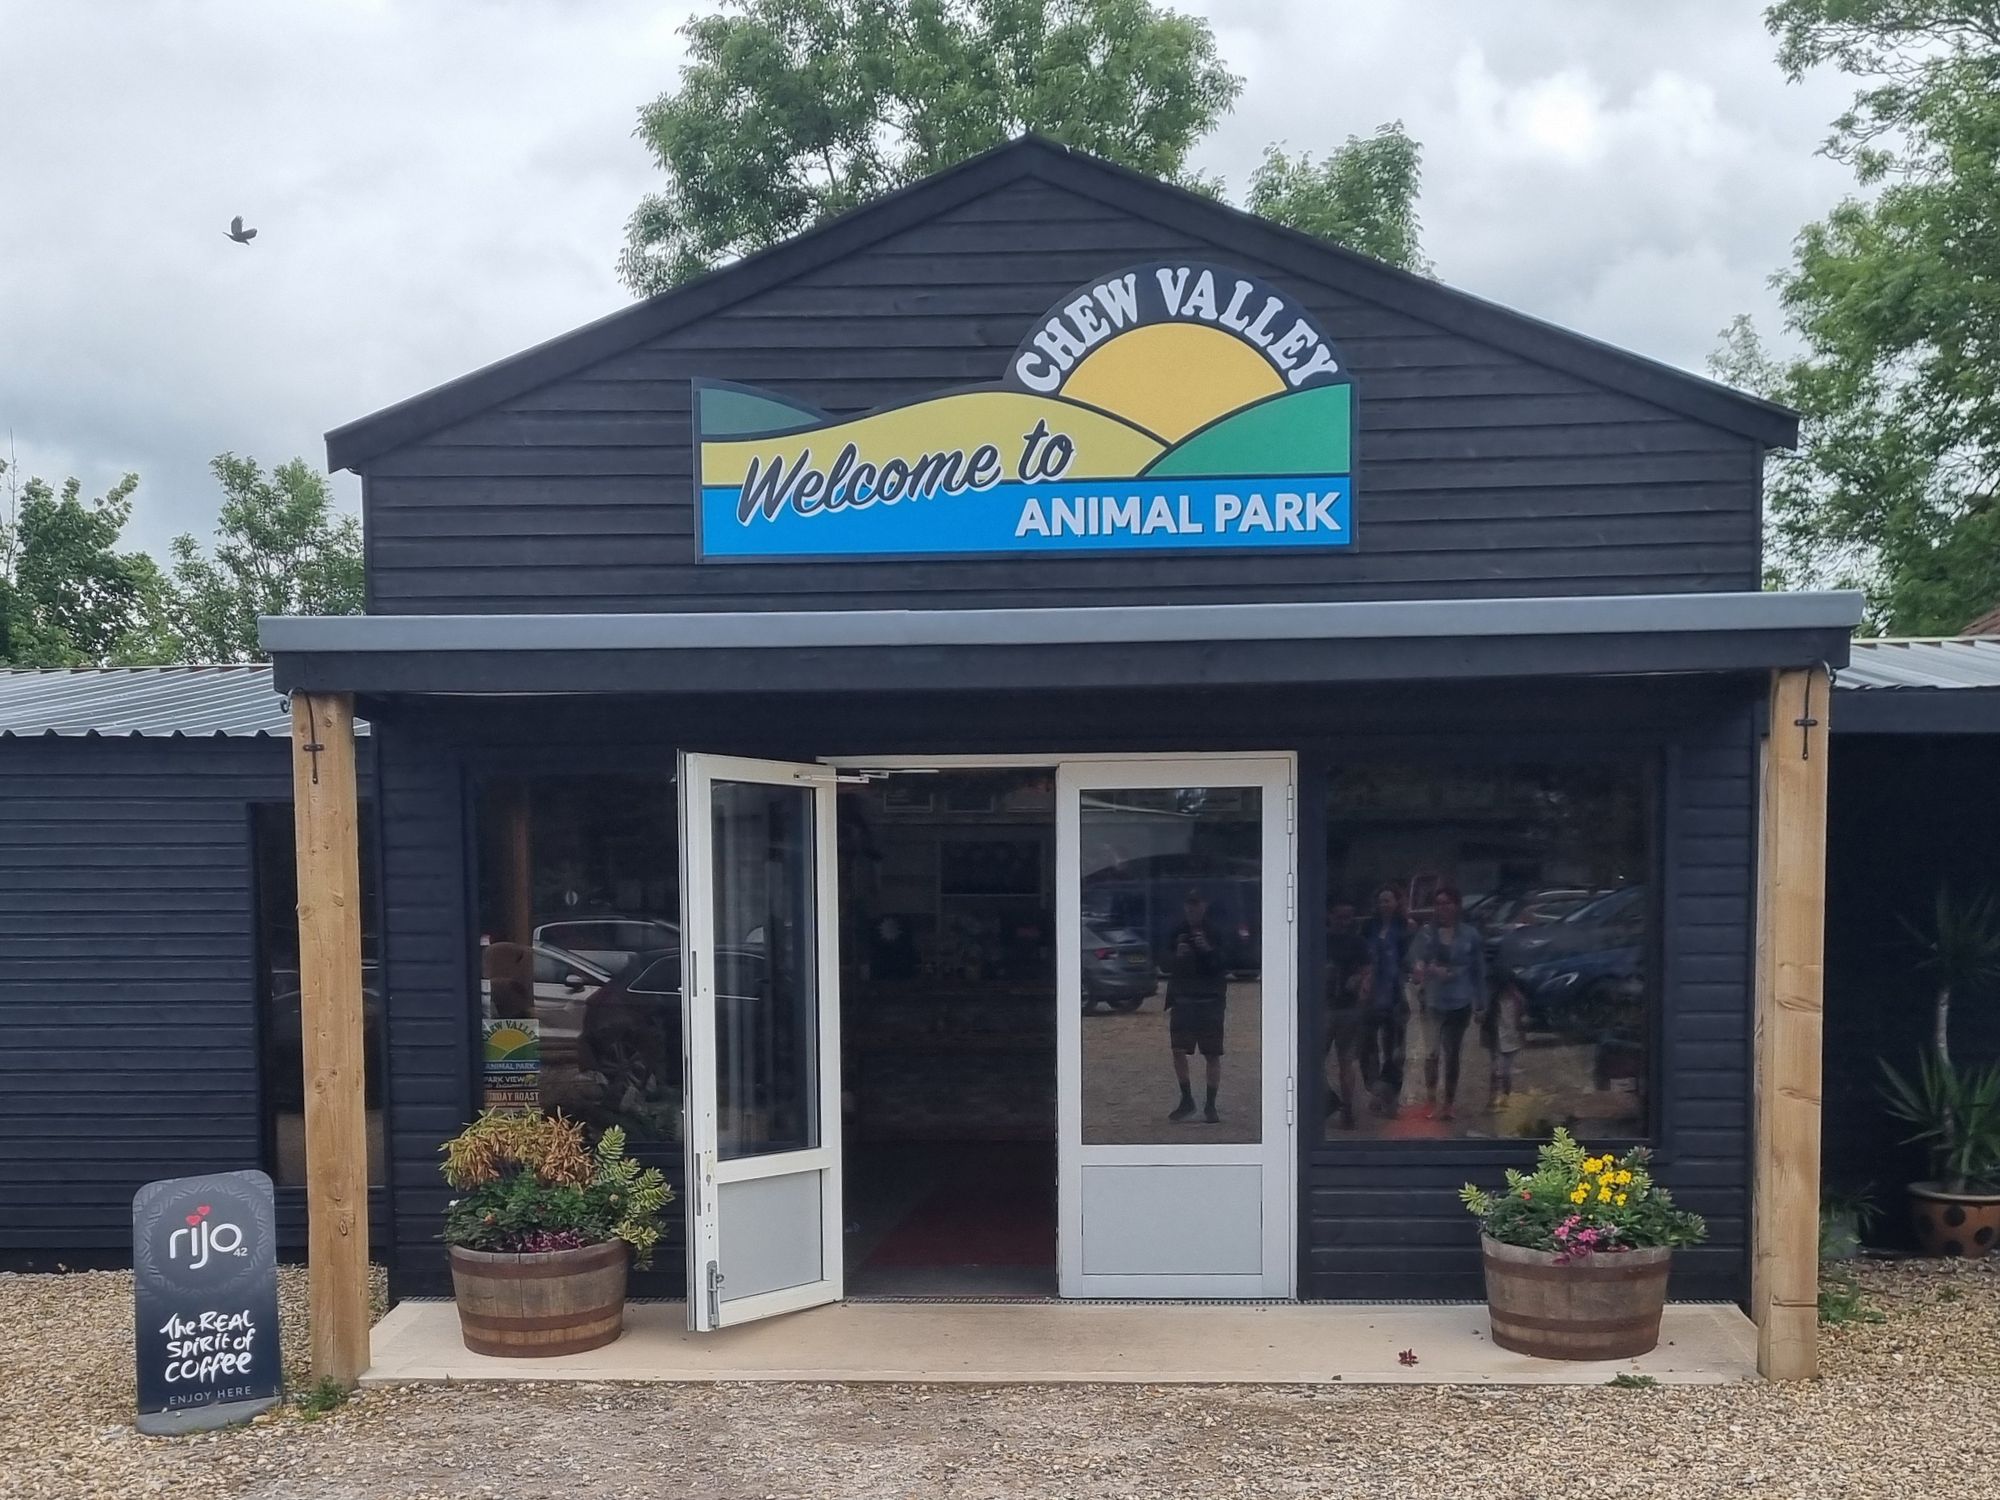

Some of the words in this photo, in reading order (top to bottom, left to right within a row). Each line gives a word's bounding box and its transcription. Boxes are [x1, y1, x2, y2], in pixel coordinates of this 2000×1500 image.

[1016, 273, 1138, 392] CHEW
[1155, 267, 1338, 386] VALLEY
[736, 441, 1002, 527] Welcome
[1017, 416, 1075, 485] to
[1014, 495, 1203, 537] ANIMAL
[1215, 492, 1342, 533] PARK
[514, 1092, 539, 1101] ROAST
[169, 1207, 242, 1269] rijo
[233, 1247, 248, 1257] 42
[233, 1328, 256, 1351] of
[169, 1391, 211, 1405] ENJOY
[217, 1385, 252, 1398] HERE
